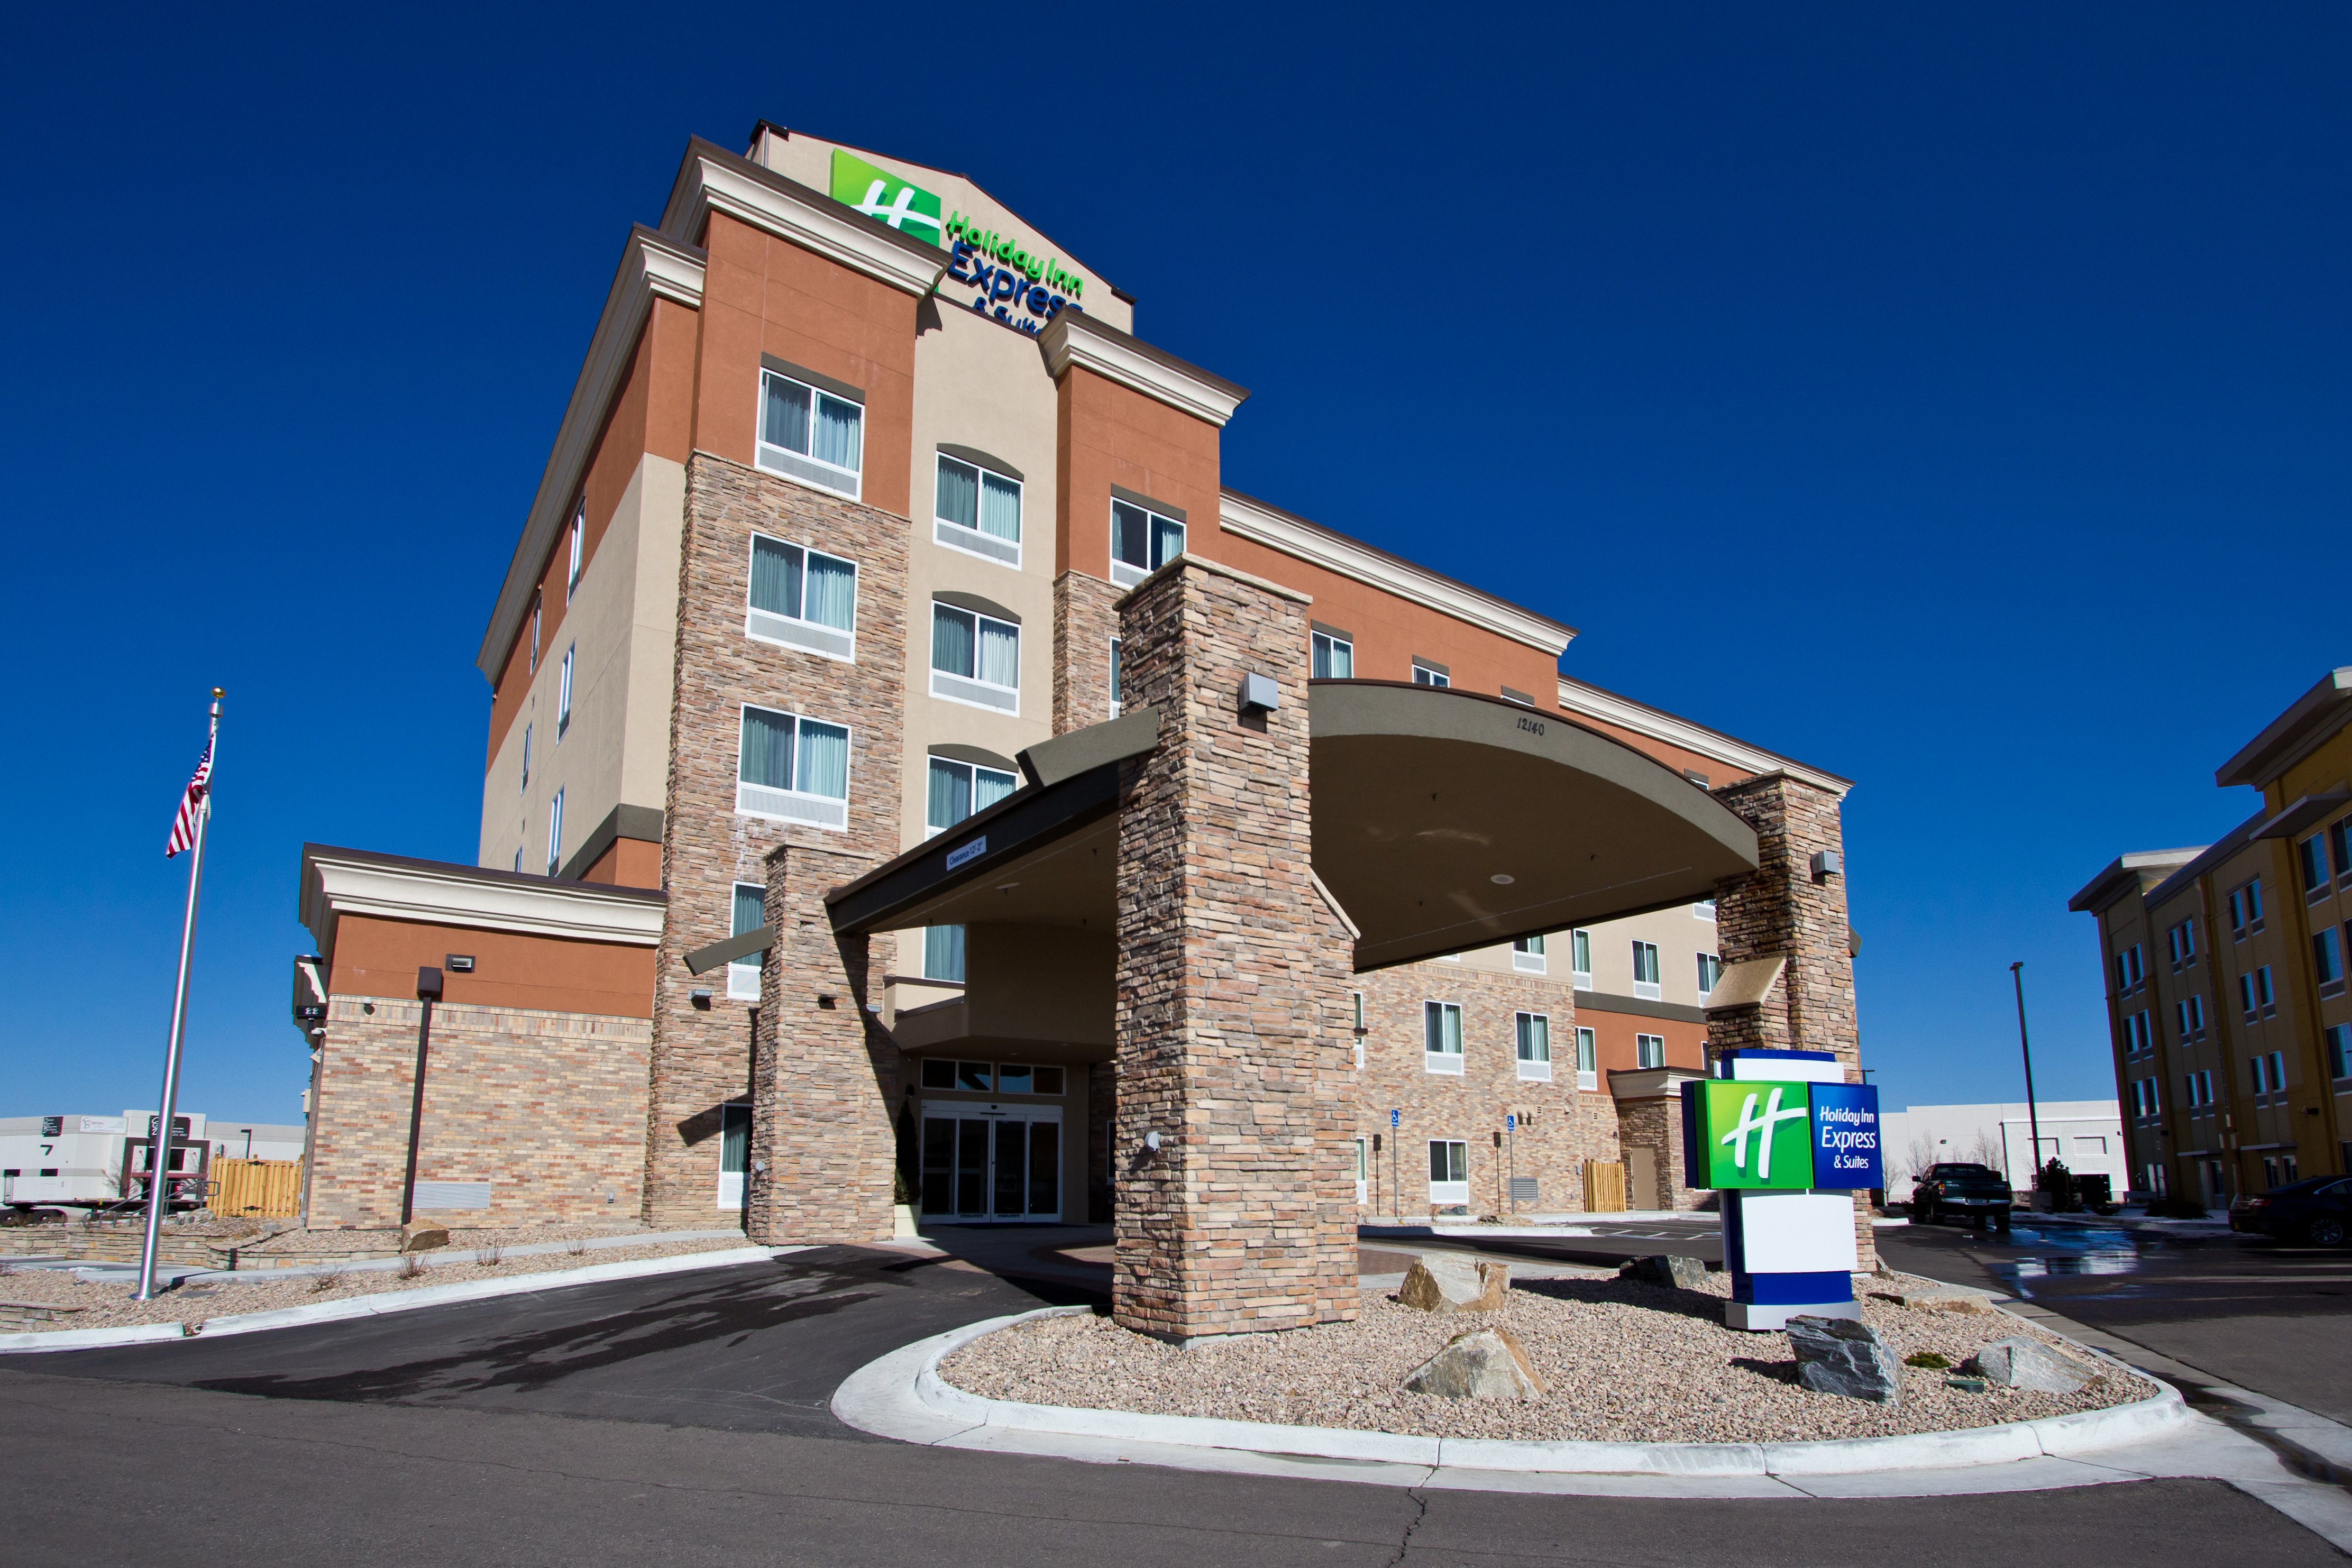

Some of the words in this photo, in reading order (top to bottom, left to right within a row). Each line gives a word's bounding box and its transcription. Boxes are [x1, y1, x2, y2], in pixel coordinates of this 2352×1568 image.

[946, 210, 1045, 282] Holiday
[1046, 258, 1083, 298] Inn
[1517, 717, 1544, 736] 12140
[949, 850, 969, 865] Clearance
[1819, 1106, 1860, 1126] Holiday
[1861, 1108, 1874, 1123] Inn
[1822, 1126, 1875, 1153] Express
[41, 1144, 53, 1156] 7
[1834, 1155, 1842, 1168] &
[1843, 1155, 1869, 1169] Suites
